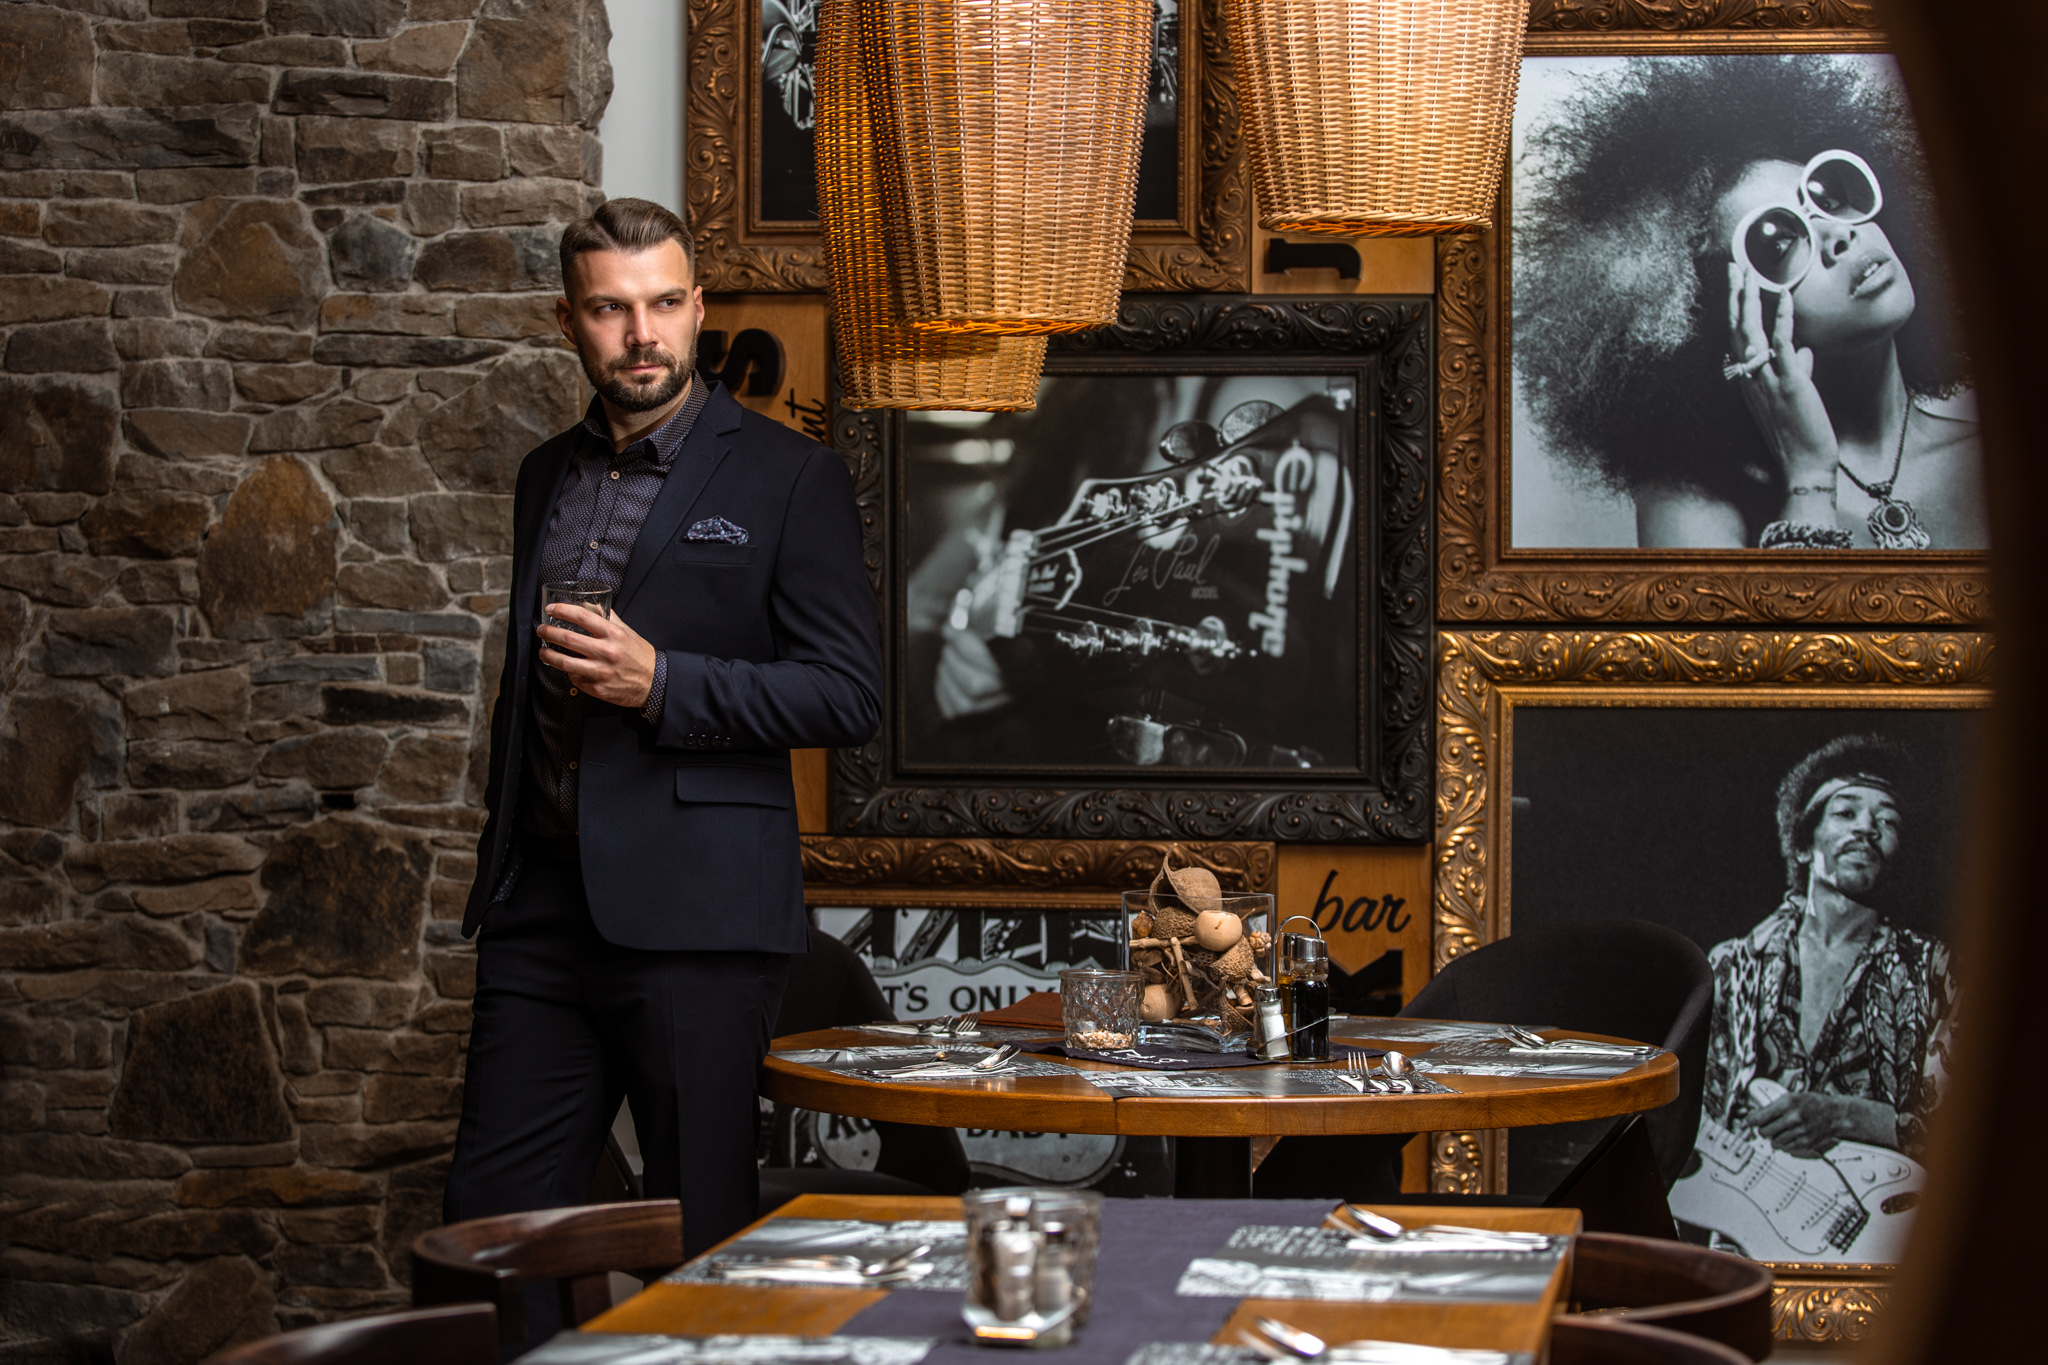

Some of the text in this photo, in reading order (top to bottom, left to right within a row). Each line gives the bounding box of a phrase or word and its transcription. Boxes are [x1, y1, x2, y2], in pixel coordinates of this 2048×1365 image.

[1153, 531, 1221, 590] Paul
[1309, 868, 1412, 933] bar
[881, 979, 1056, 1013] T'S ON
